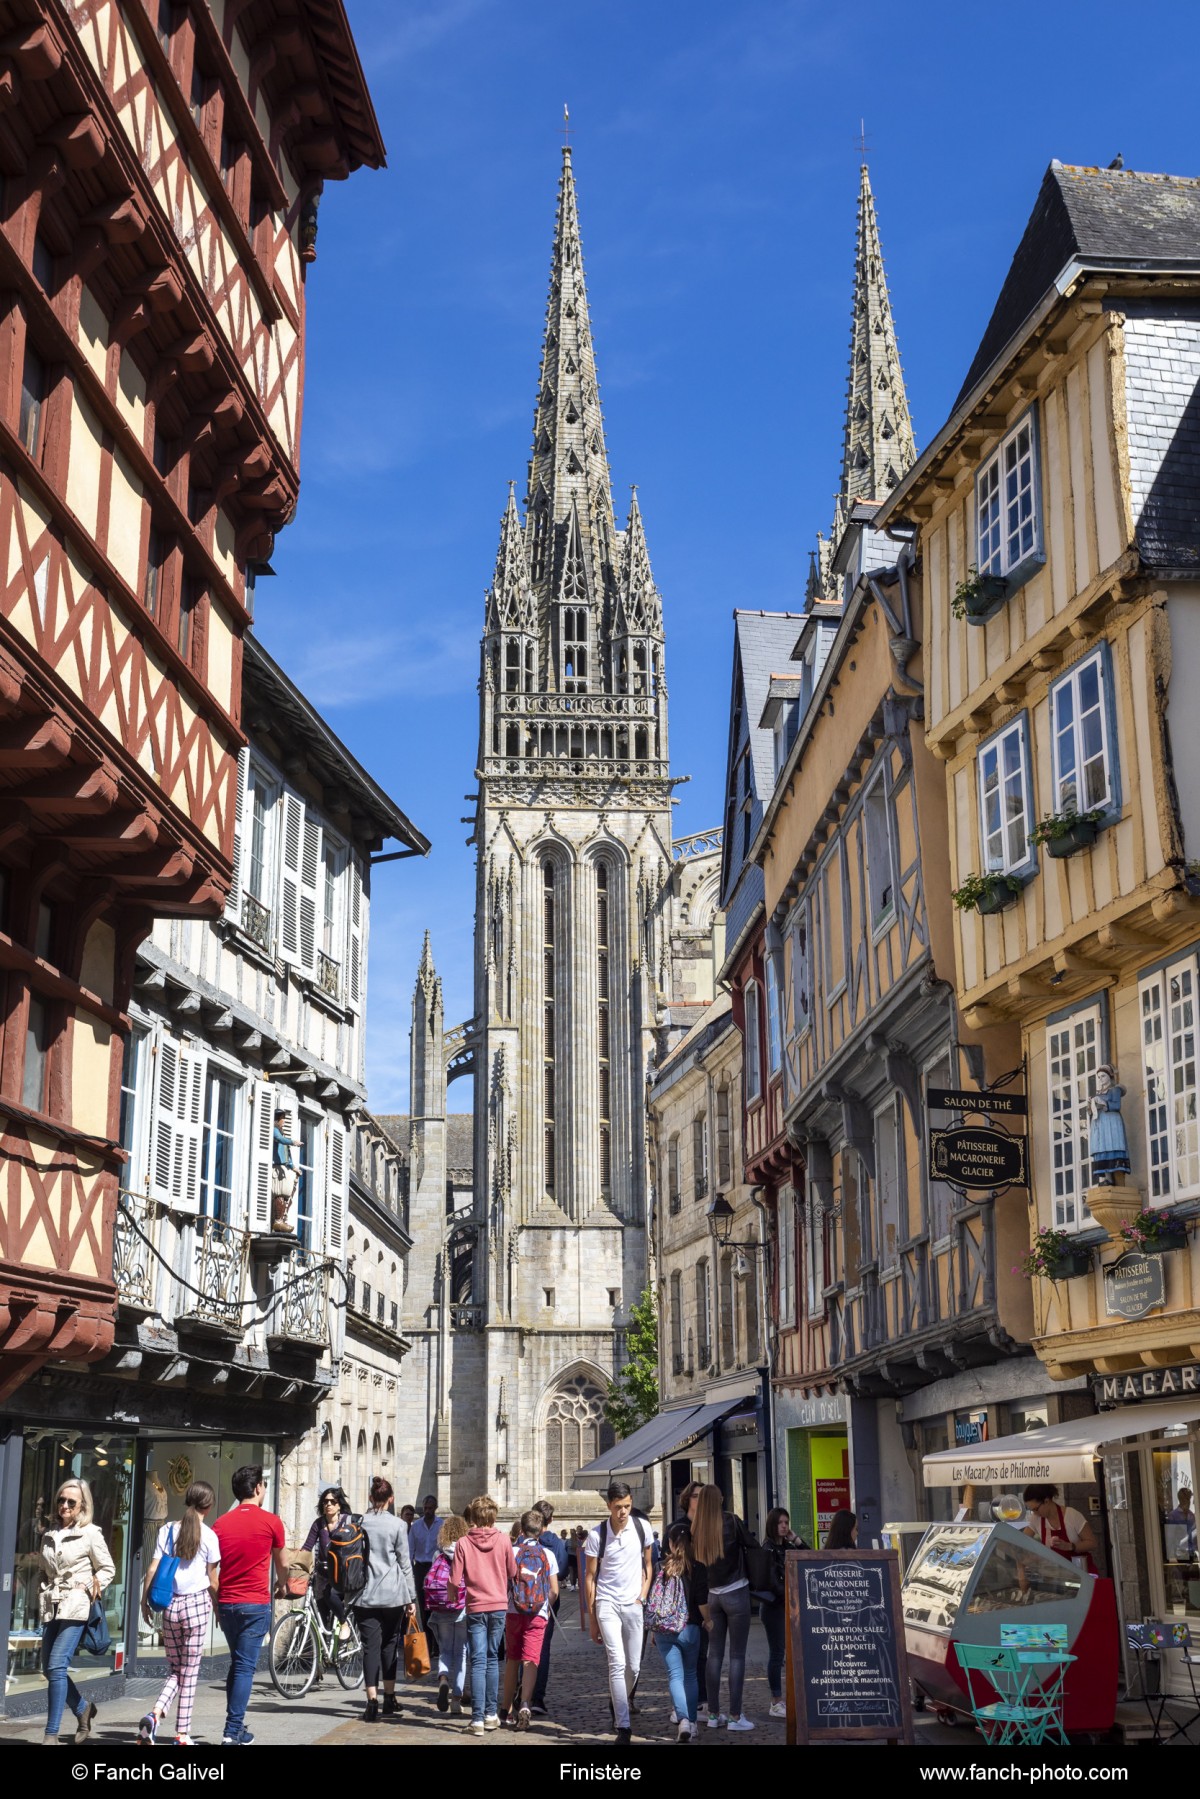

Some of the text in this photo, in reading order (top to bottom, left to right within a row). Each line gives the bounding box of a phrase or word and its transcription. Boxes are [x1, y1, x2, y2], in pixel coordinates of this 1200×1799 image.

[944, 1097, 1012, 1110] SALON DE THÉ
[957, 1140, 999, 1153] PÂTISSERIE
[950, 1153, 1006, 1165] MACARONERIE
[961, 1166, 994, 1177] GLACIER
[1115, 1262, 1150, 1280] PÂTISSERIE
[1120, 1295, 1133, 1304] SALON
[1126, 1303, 1144, 1313] GLACIER
[1103, 1367, 1196, 1400] MACAR
[952, 1461, 1050, 1481] Les Macarons de Philomène
[824, 1569, 863, 1578] PÂTISSERIE
[818, 1580, 870, 1588] MACARONERIE
[855, 1589, 870, 1597] THÉ
[811, 1626, 863, 1634] RESTAURATION
[821, 1642, 877, 1651] OU À EMPORTER
[833, 1660, 867, 1668] Découvrez
[840, 1667, 856, 1677] large
[857, 1668, 880, 1677] gamme
[810, 1676, 819, 1684] de
[820, 1676, 853, 1685] pâtisseries
[861, 1689, 876, 1697] mois
